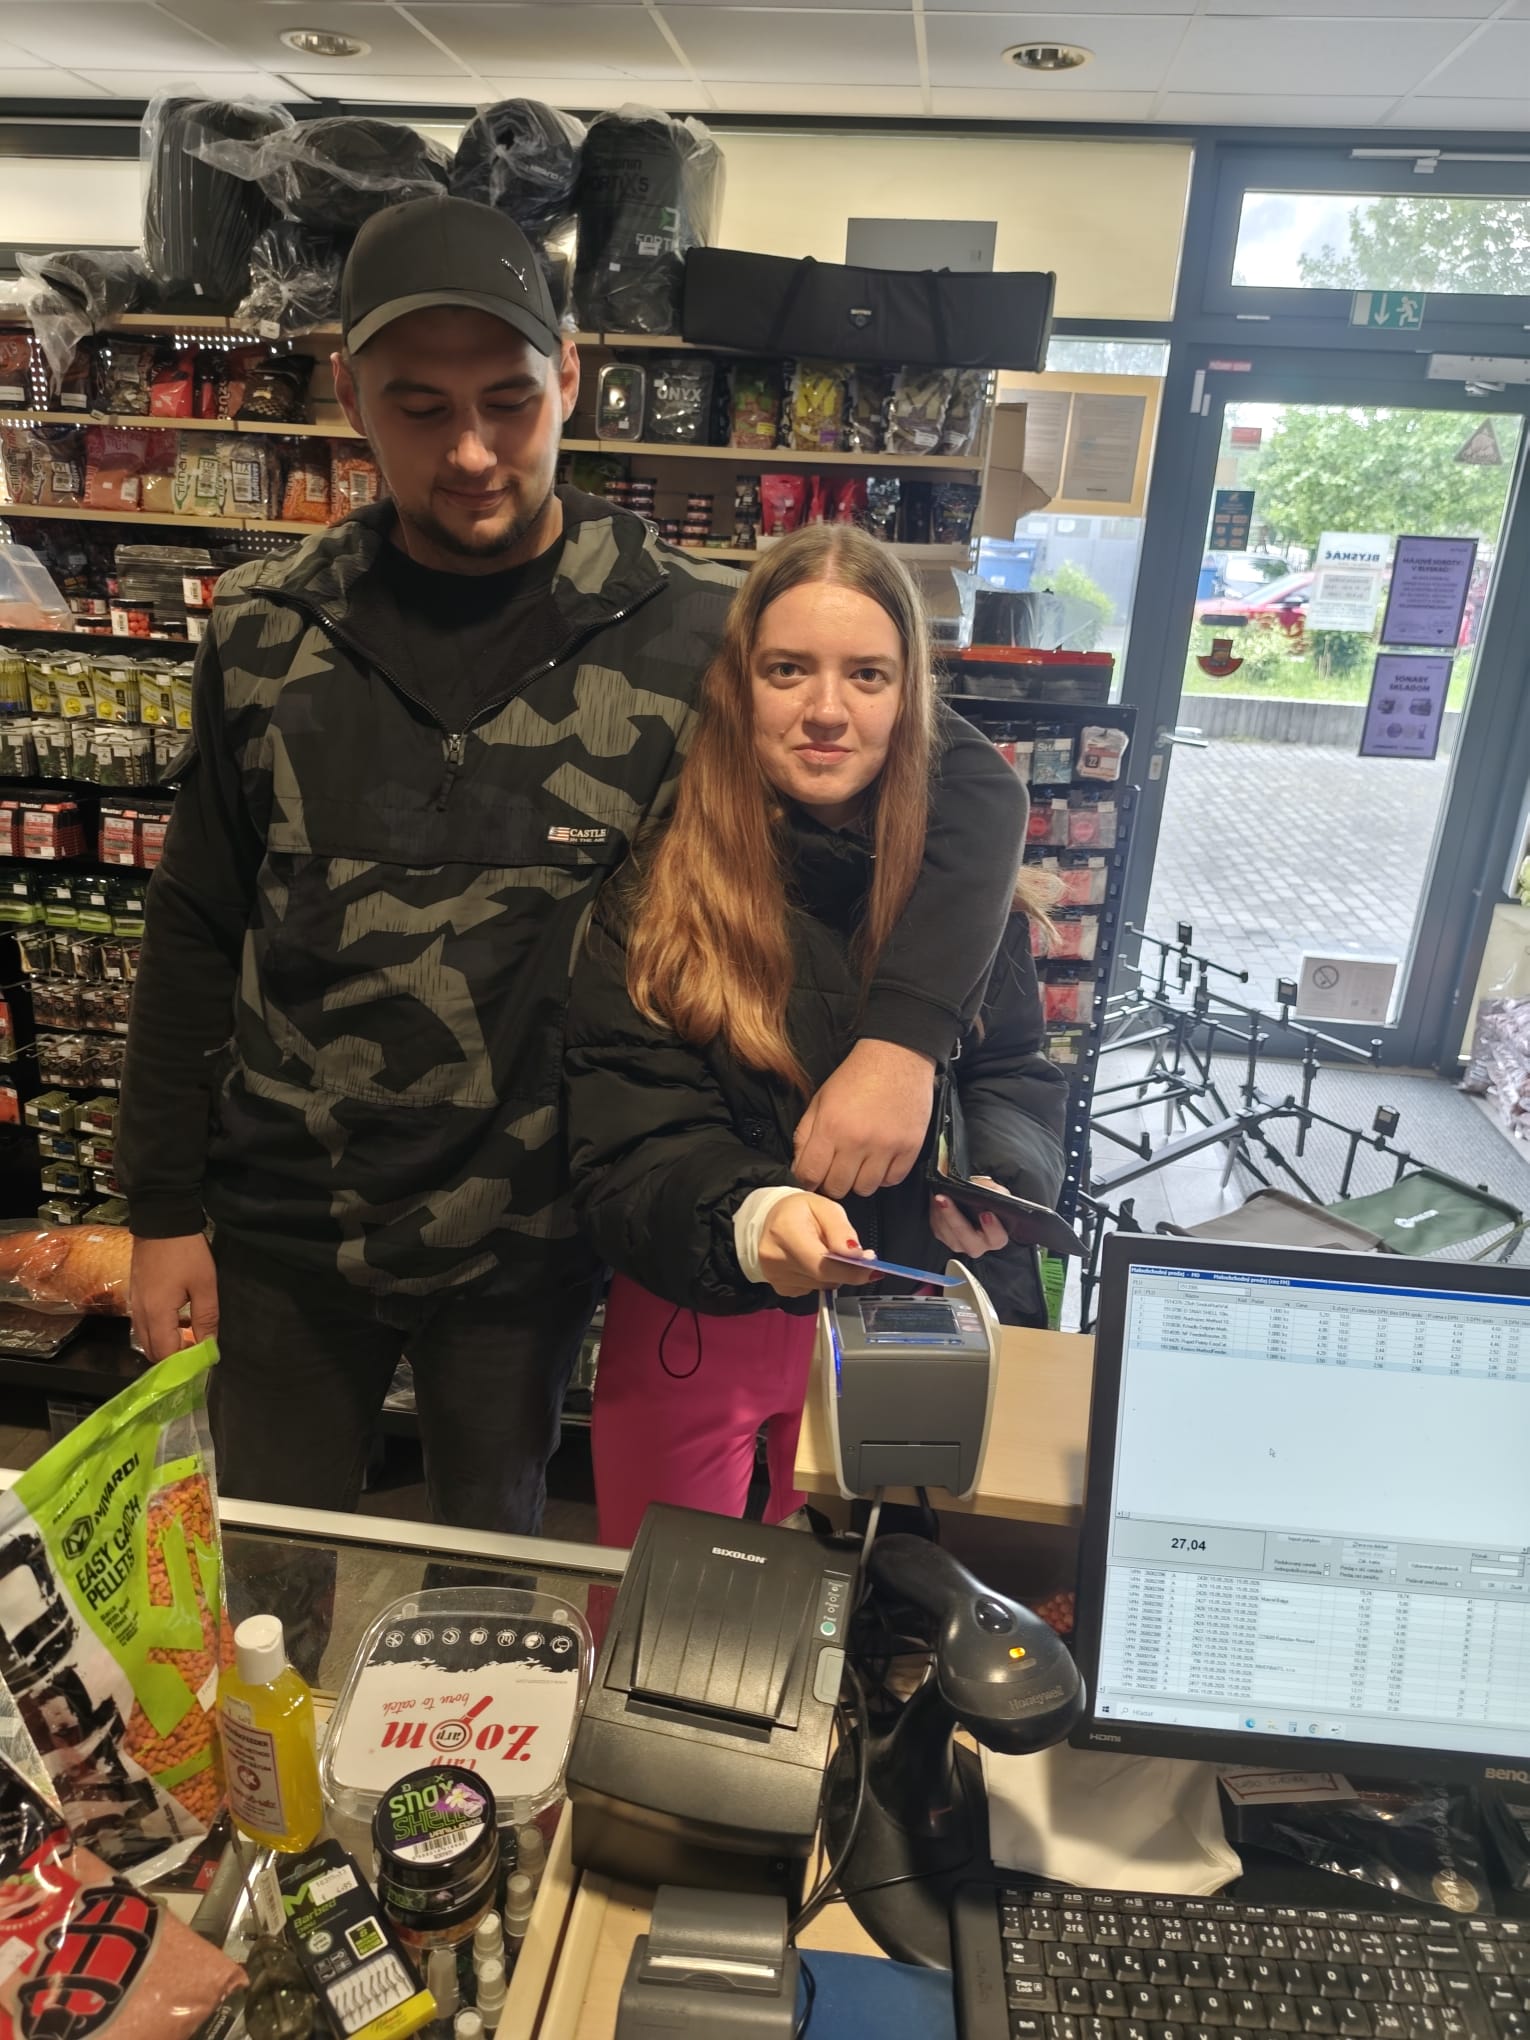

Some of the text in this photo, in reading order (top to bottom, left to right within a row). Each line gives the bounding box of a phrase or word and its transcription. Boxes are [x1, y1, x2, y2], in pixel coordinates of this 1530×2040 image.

[656, 387, 702, 402] ONYX
[570, 828, 607, 838] CASTLE
[95, 1453, 140, 1525] MIVARDI
[75, 1494, 142, 1593] EASY CATCH
[1171, 1538, 1206, 1551] 27,04
[711, 1546, 767, 1564] BIXOLON
[85, 1547, 136, 1611] PELLETS
[383, 1693, 470, 1716] born to catch
[1008, 1685, 1065, 1712] Honeywell
[1089, 1733, 1122, 1743] HDMI
[1108, 1915, 1115, 1923] 3
[1174, 1920, 1181, 1928] 5
[1207, 1922, 1214, 1930] 6
[1057, 1951, 1065, 1960] Q
[1088, 1953, 1099, 1962] W
[1124, 1955, 1132, 1964] E
[1157, 1958, 1167, 1968] R
[1192, 1960, 1199, 1970] T
[1224, 1957, 1231, 1966] Y
[1259, 1966, 1268, 1975] U
[1327, 1970, 1337, 1981] O
[1361, 1973, 1370, 1983] P
[1227, 1969, 1236, 1979] Z
[1071, 1987, 1079, 1996] A
[1105, 1989, 1114, 1999] S
[1140, 1992, 1149, 2001] D
[1174, 1995, 1181, 2004] F
[1243, 2000, 1253, 2010] H
[1279, 2003, 1286, 2013] J
[1312, 2005, 1322, 2015] K
[1346, 2007, 1356, 2018] L
[1093, 2018, 1101, 2028] Z
[1129, 2028, 1137, 2038] X
